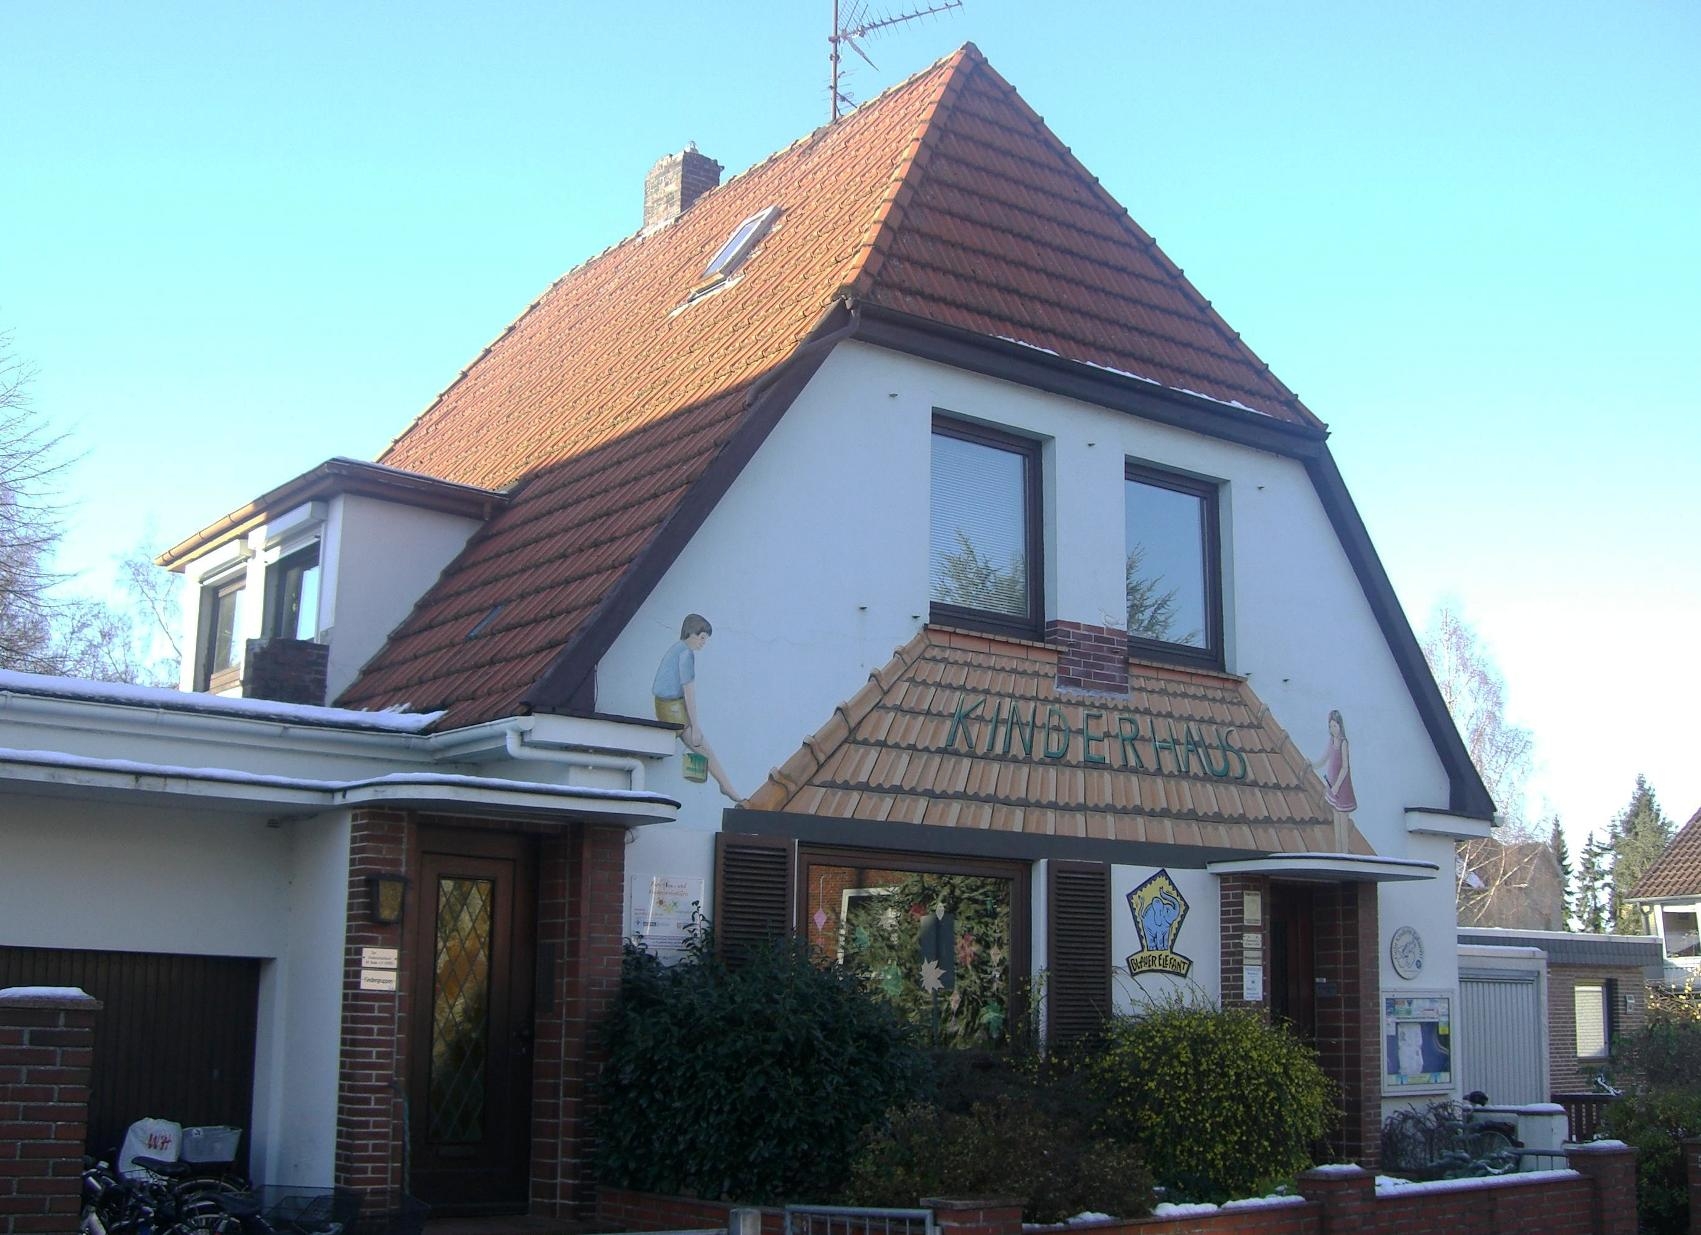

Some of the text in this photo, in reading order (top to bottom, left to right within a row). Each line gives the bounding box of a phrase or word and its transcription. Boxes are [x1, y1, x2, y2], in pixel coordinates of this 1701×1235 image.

[946, 694, 1248, 780] KINDERHAUS
[1130, 953, 1188, 973] BLAUER ELEFANT
